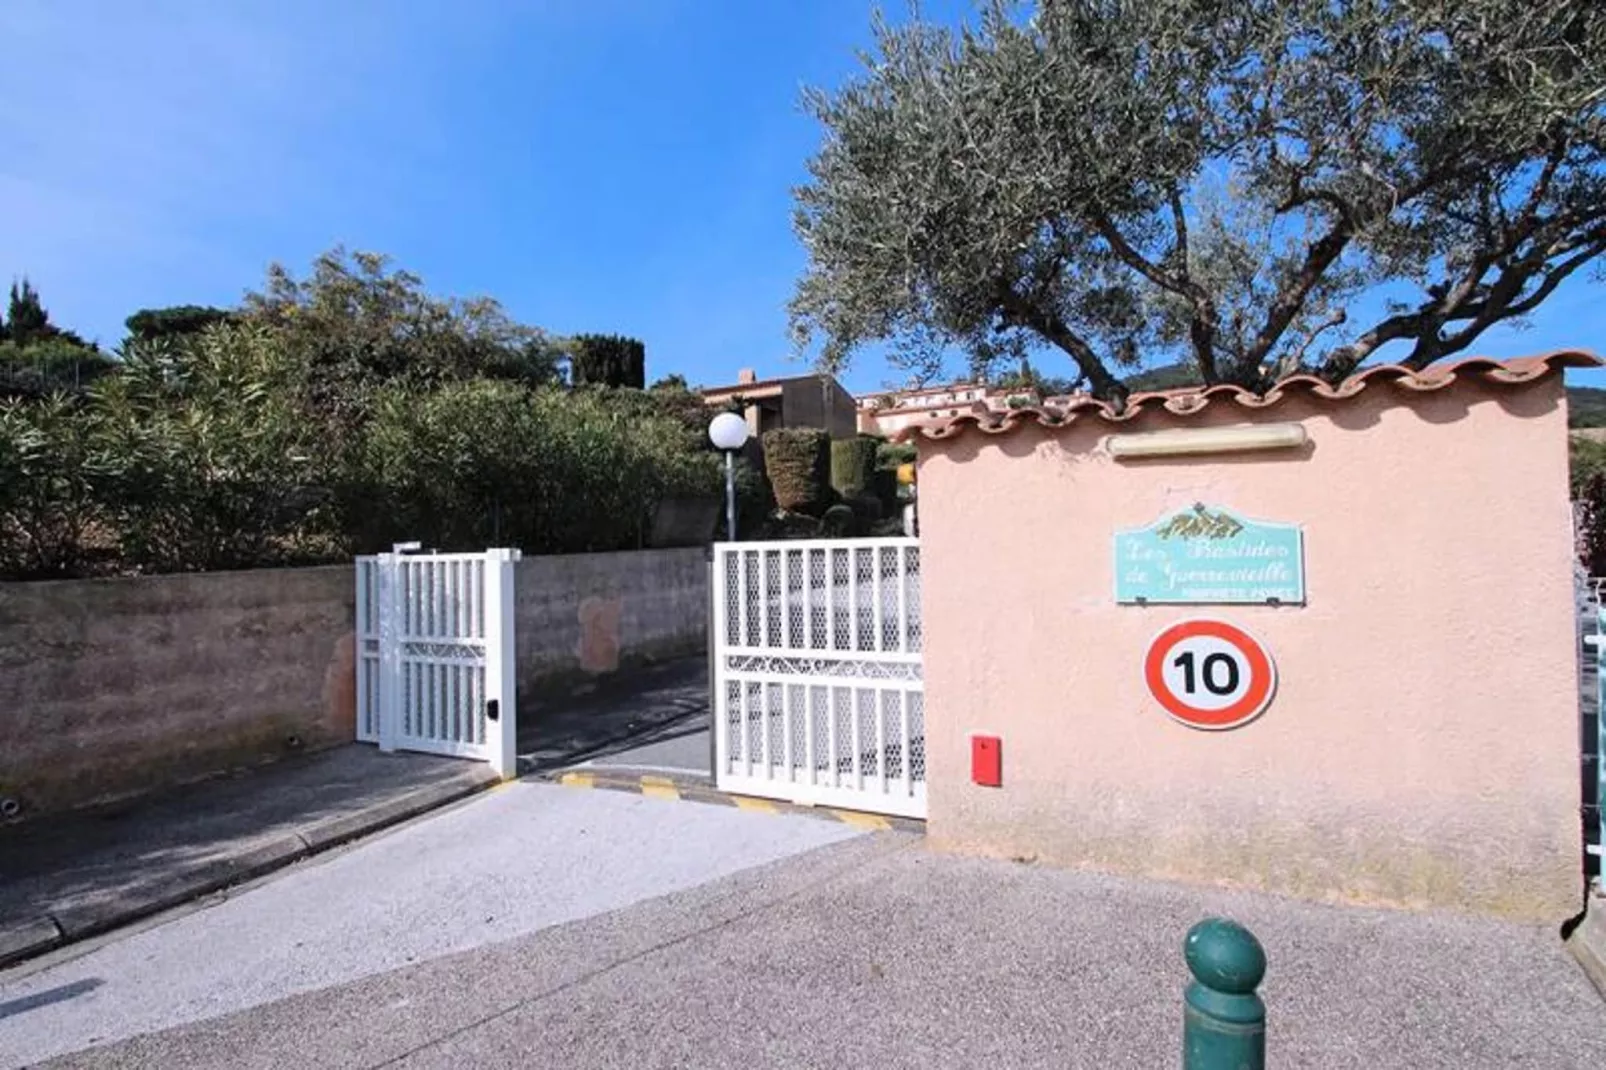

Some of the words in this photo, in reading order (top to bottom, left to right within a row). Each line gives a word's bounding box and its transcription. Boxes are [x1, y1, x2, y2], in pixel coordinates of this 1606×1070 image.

[1125, 539, 1167, 560] Les
[1125, 565, 1149, 583] de
[1174, 651, 1239, 695] 10
